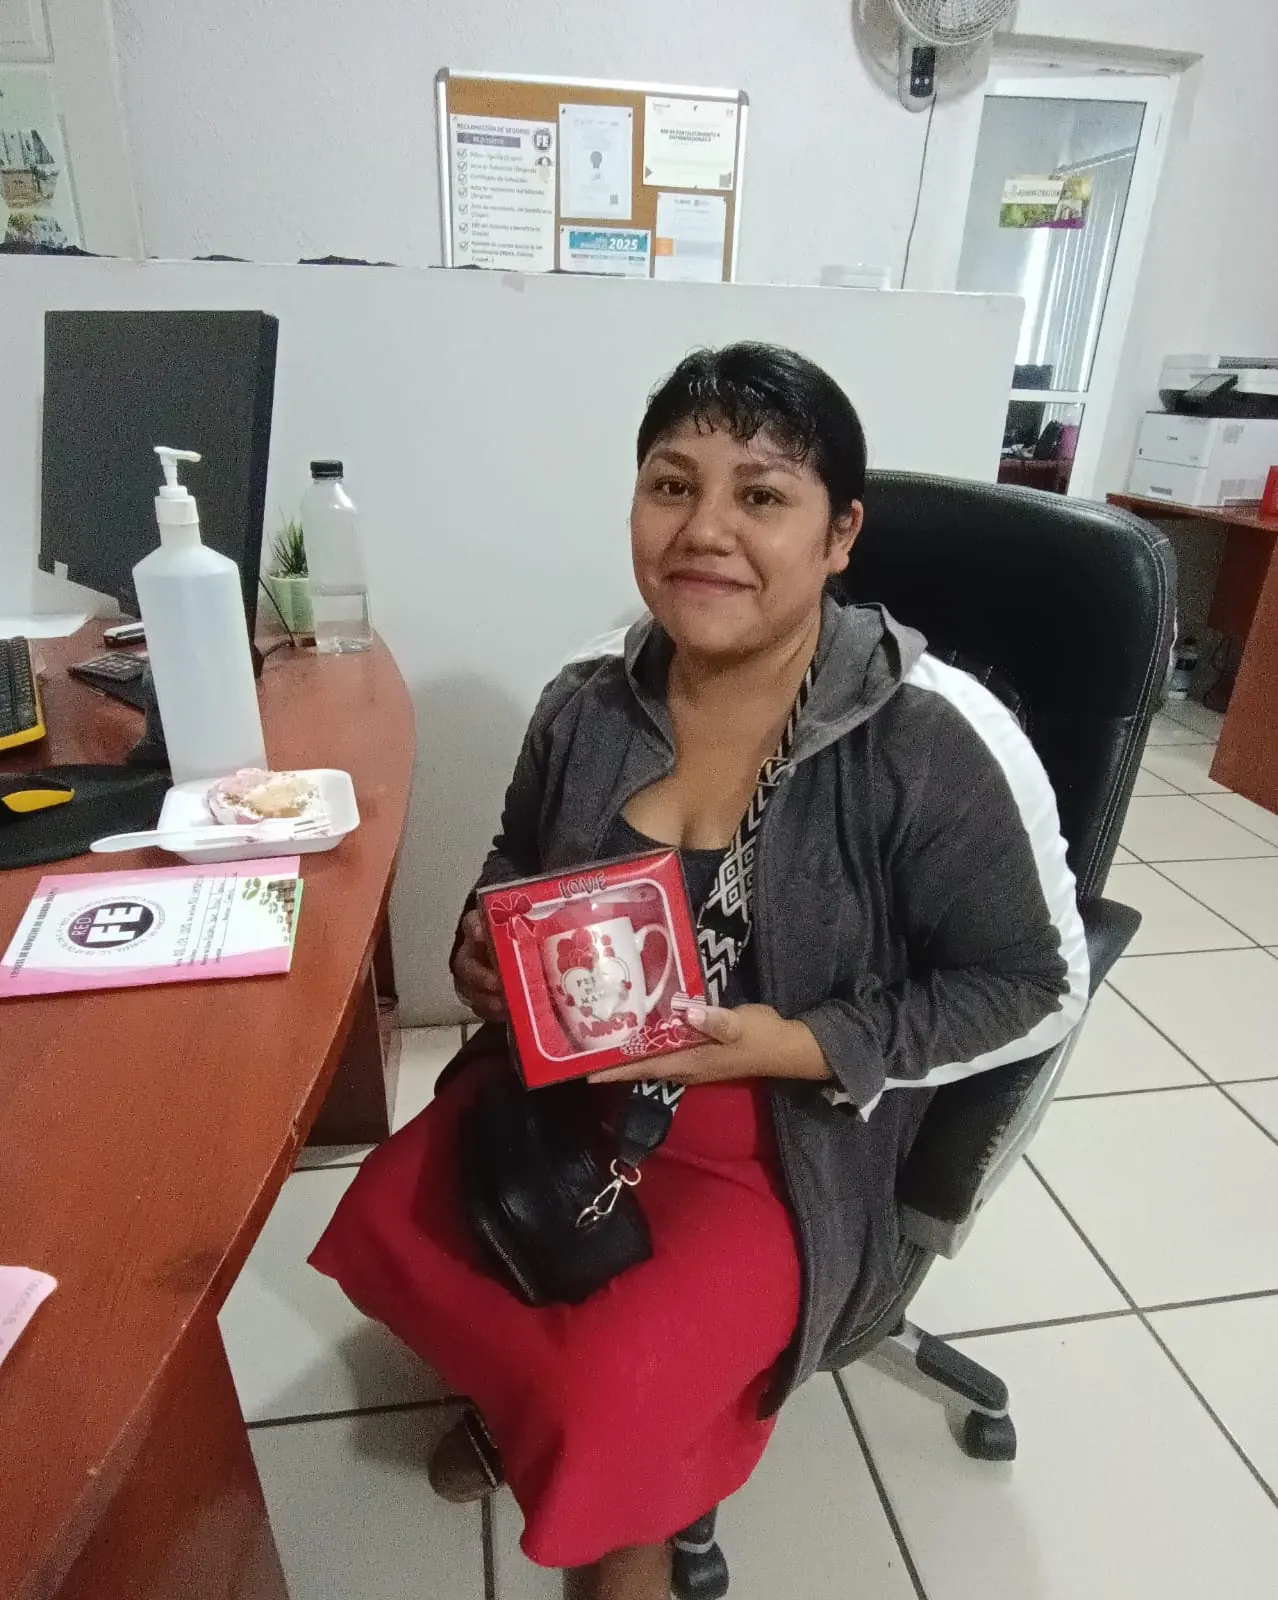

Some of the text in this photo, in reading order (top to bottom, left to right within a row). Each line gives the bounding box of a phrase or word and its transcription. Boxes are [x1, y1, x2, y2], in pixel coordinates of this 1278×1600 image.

[608, 238, 638, 250] 2025
[559, 874, 607, 898] LOVE
[71, 917, 92, 936] RED
[86, 906, 144, 943] FE
